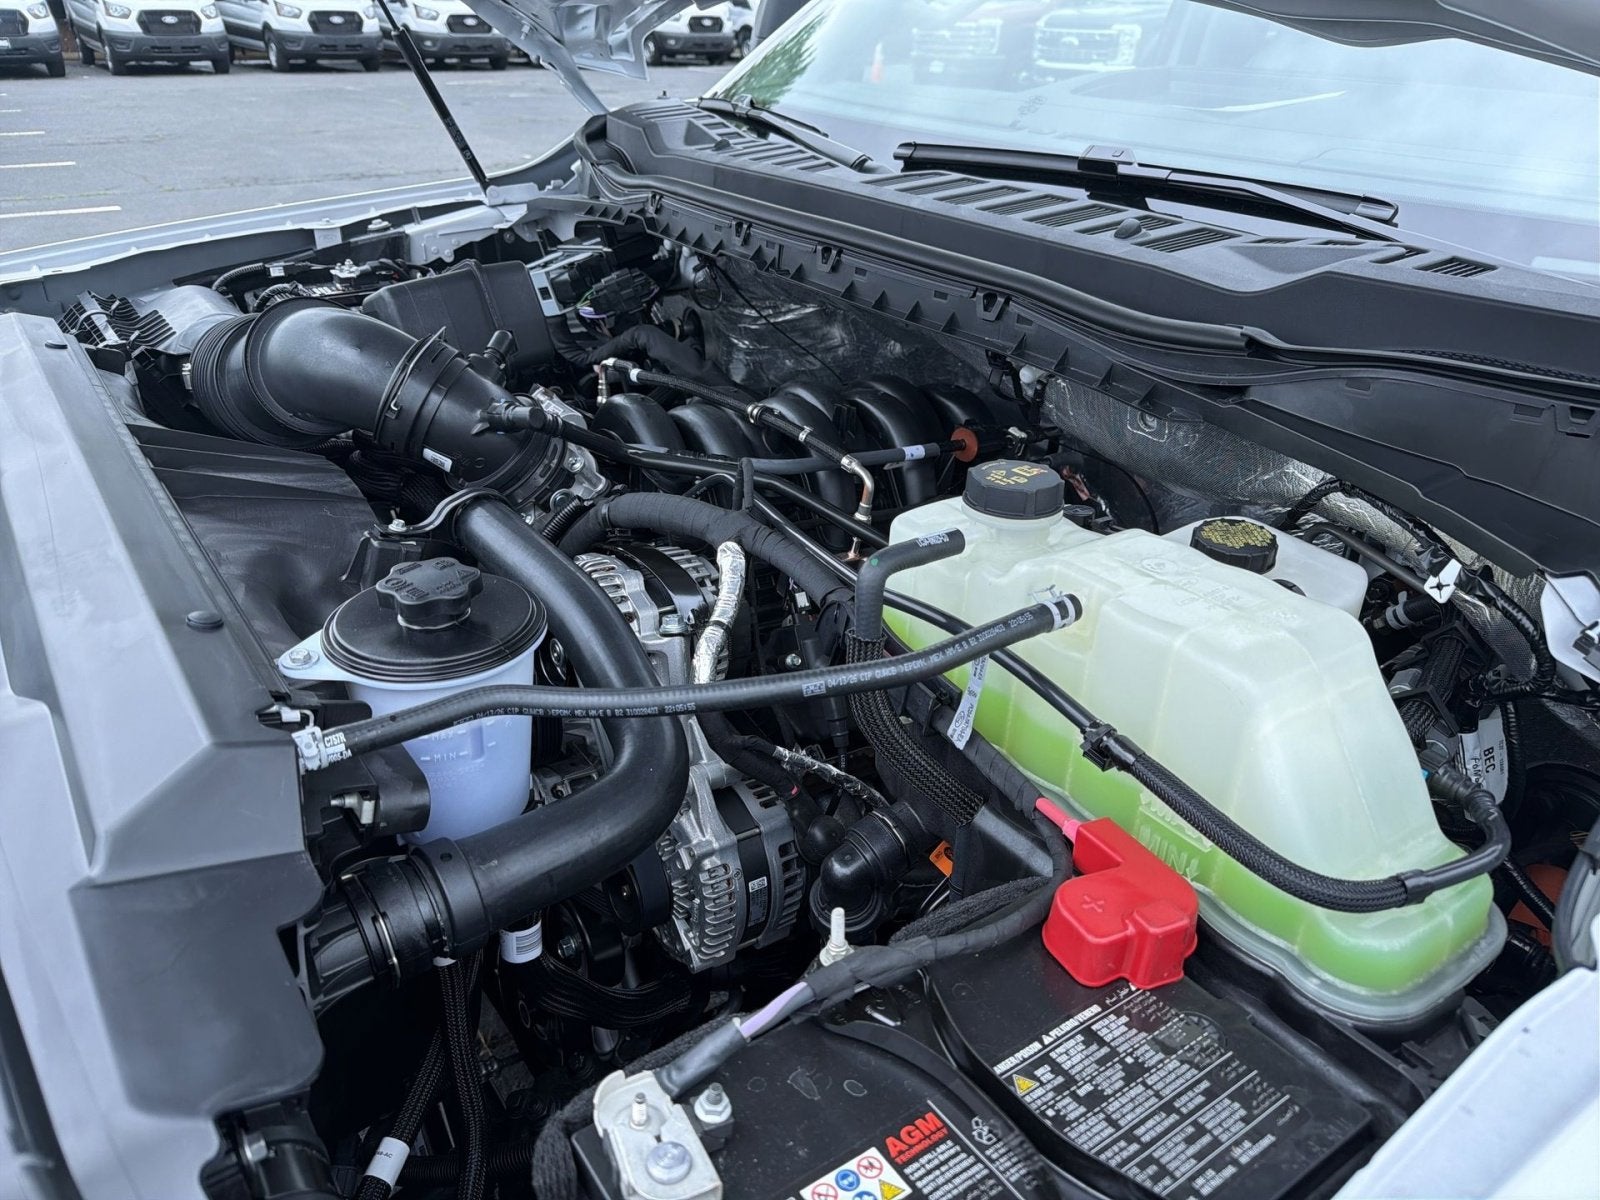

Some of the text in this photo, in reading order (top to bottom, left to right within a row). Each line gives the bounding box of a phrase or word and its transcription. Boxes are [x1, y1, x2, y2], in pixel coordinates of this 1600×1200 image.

[433, 752, 456, 763] MIN
[1483, 746, 1496, 774] BEC
[885, 1112, 944, 1159] AGM
[894, 1127, 949, 1165] TECHNOLOGY
[903, 1139, 955, 1176] NON-SPILLABLE
[924, 1157, 940, 1171] Acid
[938, 1144, 962, 1162] Battery
